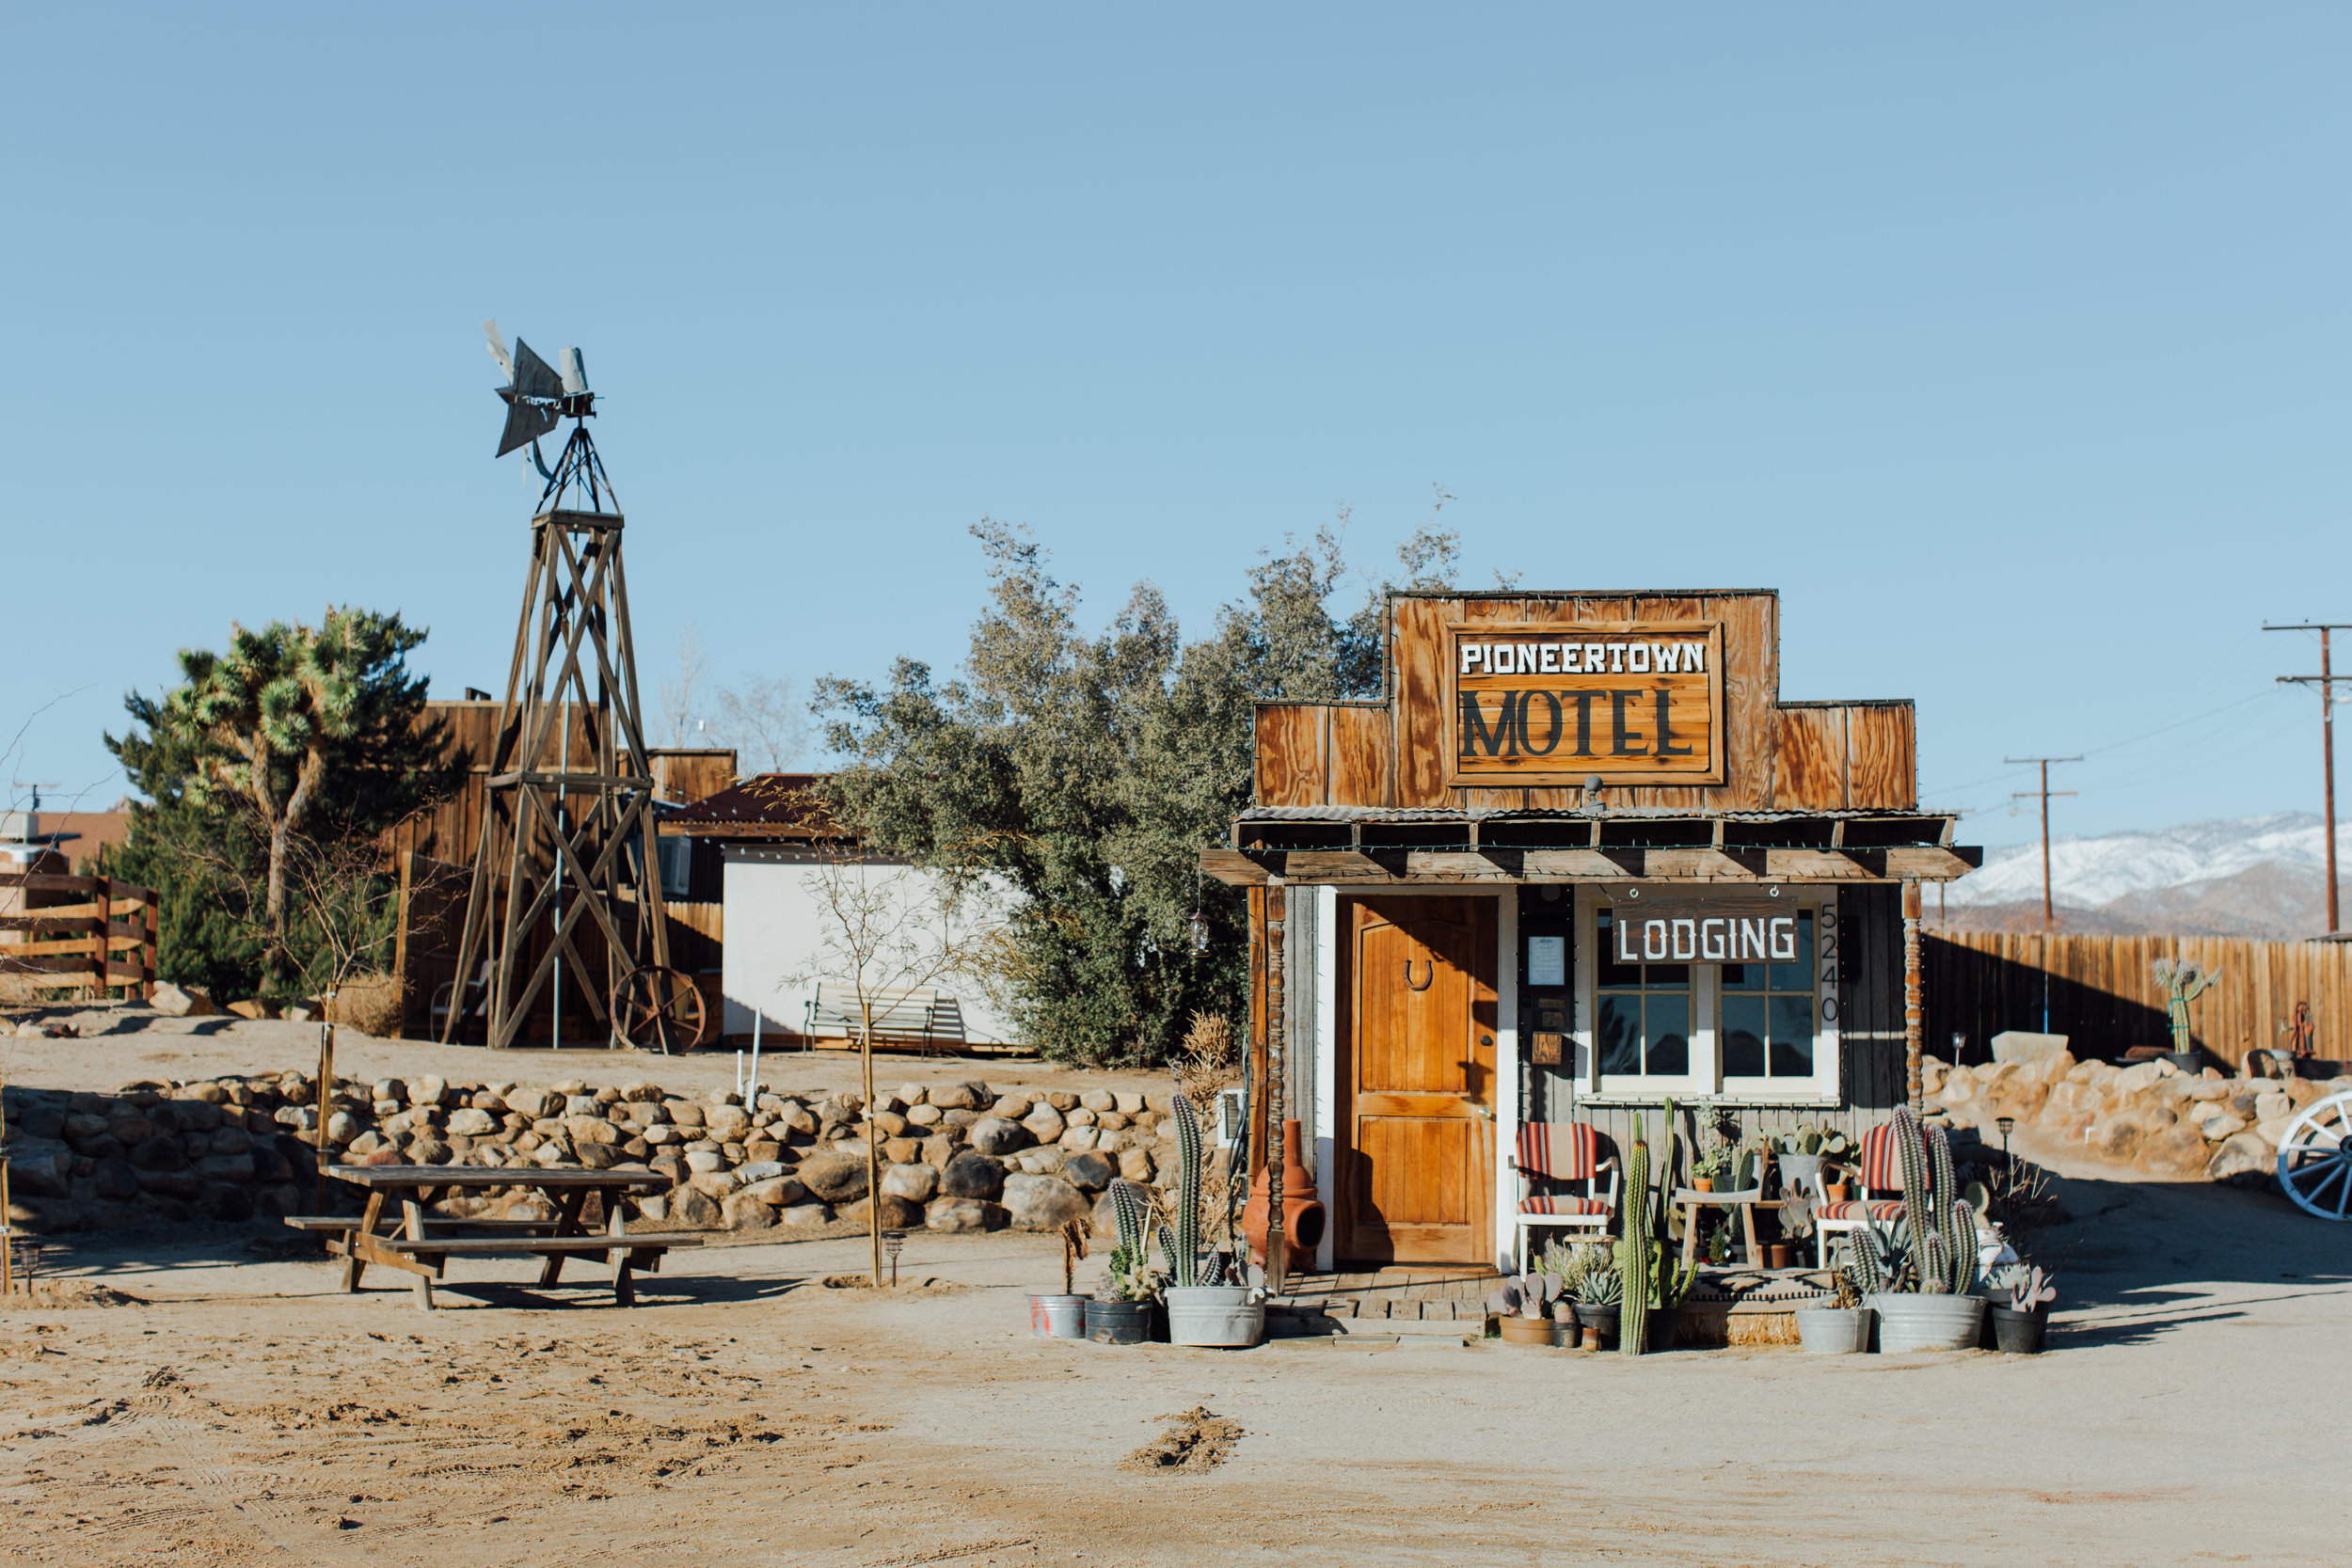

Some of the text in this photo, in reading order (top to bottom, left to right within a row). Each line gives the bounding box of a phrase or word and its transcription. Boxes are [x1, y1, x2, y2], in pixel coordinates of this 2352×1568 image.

[1460, 642, 1705, 673] PIONEERTOWN
[1459, 689, 1692, 756] MOTEL
[1619, 917, 1796, 960] LODGING
[1821, 904, 1838, 1022] 5240
